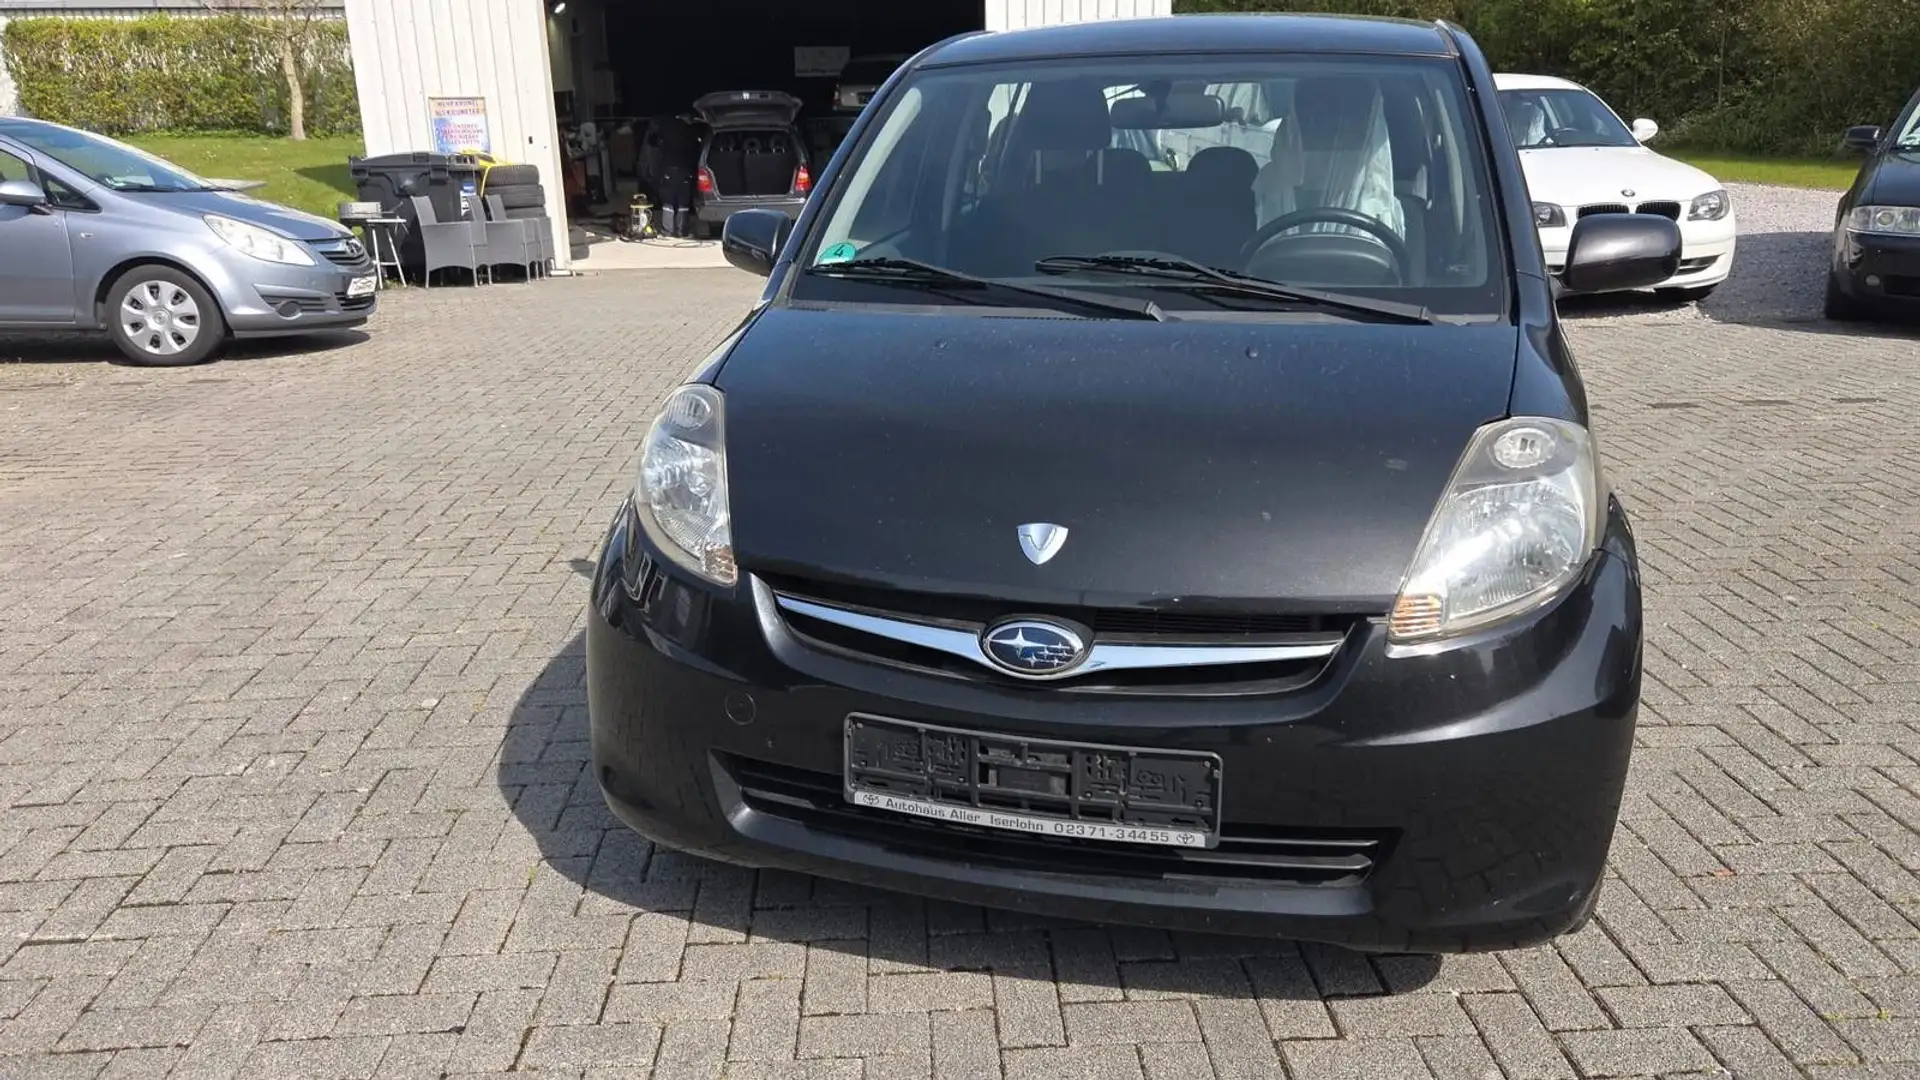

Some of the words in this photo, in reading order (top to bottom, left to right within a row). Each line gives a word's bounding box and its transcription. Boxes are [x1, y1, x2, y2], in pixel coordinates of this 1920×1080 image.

[833, 244, 845, 257] 4
[885, 798, 945, 818] Autohaus
[950, 809, 980, 822] Aller
[990, 814, 1044, 831] Iserlohn
[1054, 823, 1169, 843] 02371-34455
